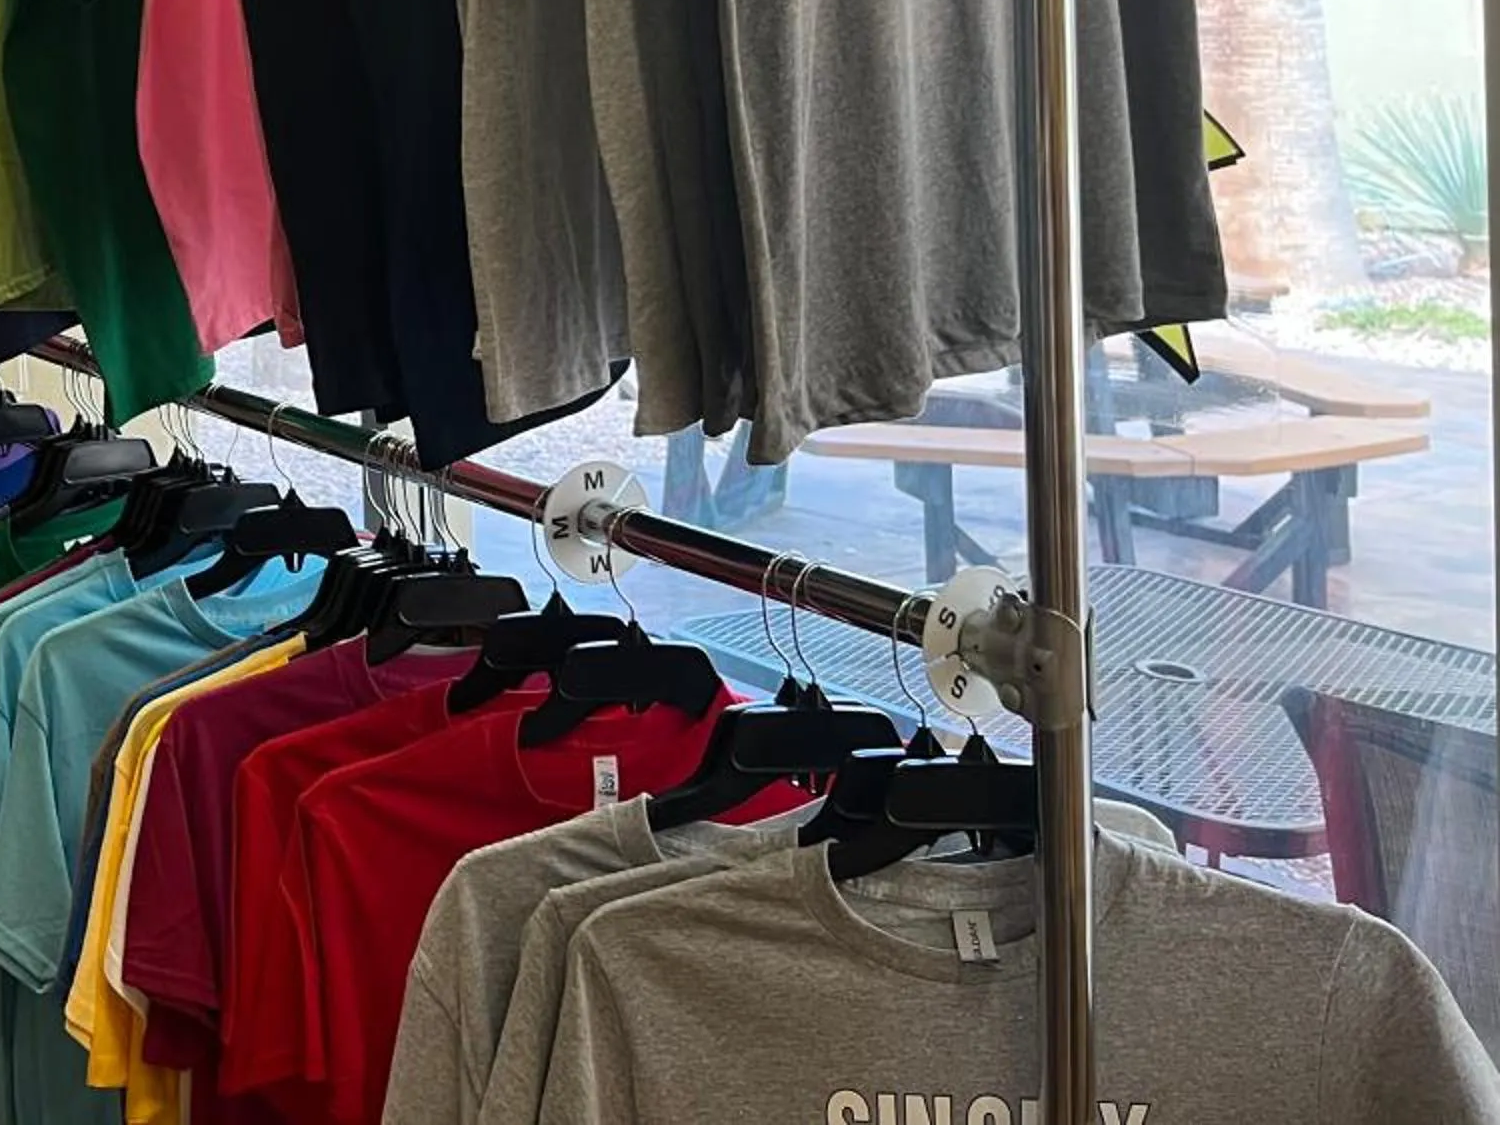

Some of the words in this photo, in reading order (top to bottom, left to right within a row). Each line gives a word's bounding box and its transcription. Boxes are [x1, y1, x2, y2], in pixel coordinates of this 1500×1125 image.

[583, 469, 605, 492] M
[938, 606, 957, 630] S
[950, 674, 968, 700] S
